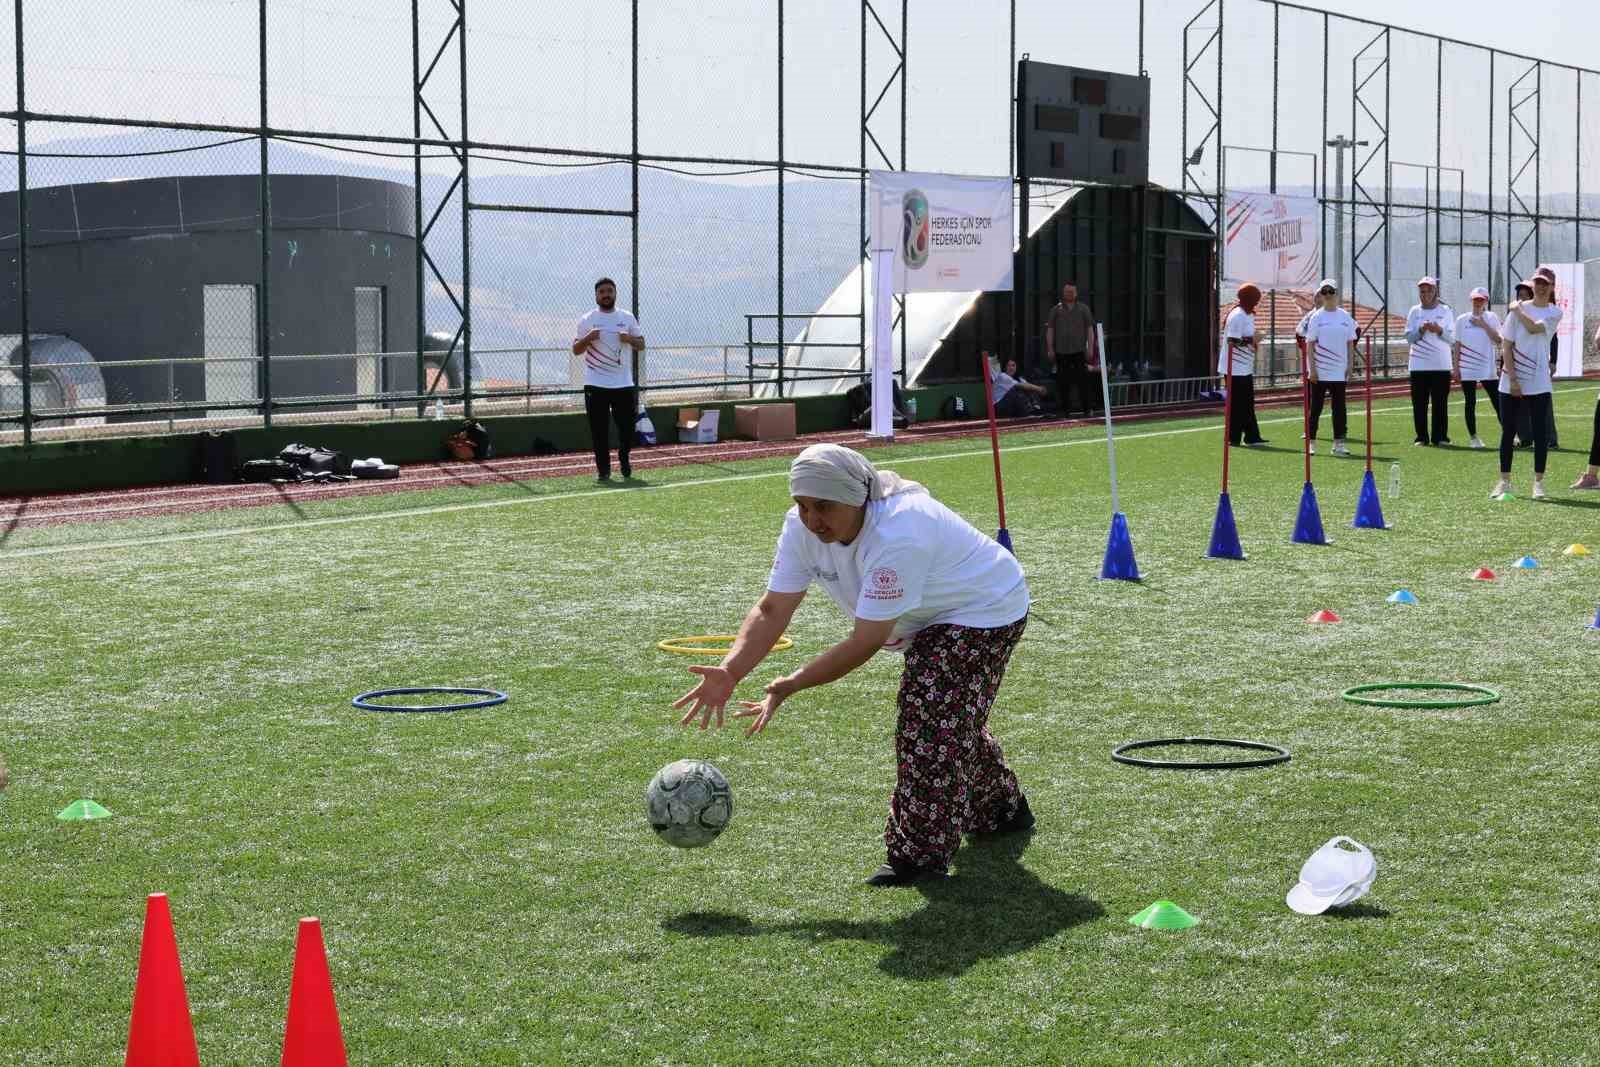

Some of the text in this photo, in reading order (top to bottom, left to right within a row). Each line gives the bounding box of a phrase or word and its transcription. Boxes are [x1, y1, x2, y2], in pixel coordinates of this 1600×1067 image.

[931, 216, 958, 229] HERKES
[975, 216, 992, 229] SPOR
[931, 232, 982, 245] FEDERASYONU
